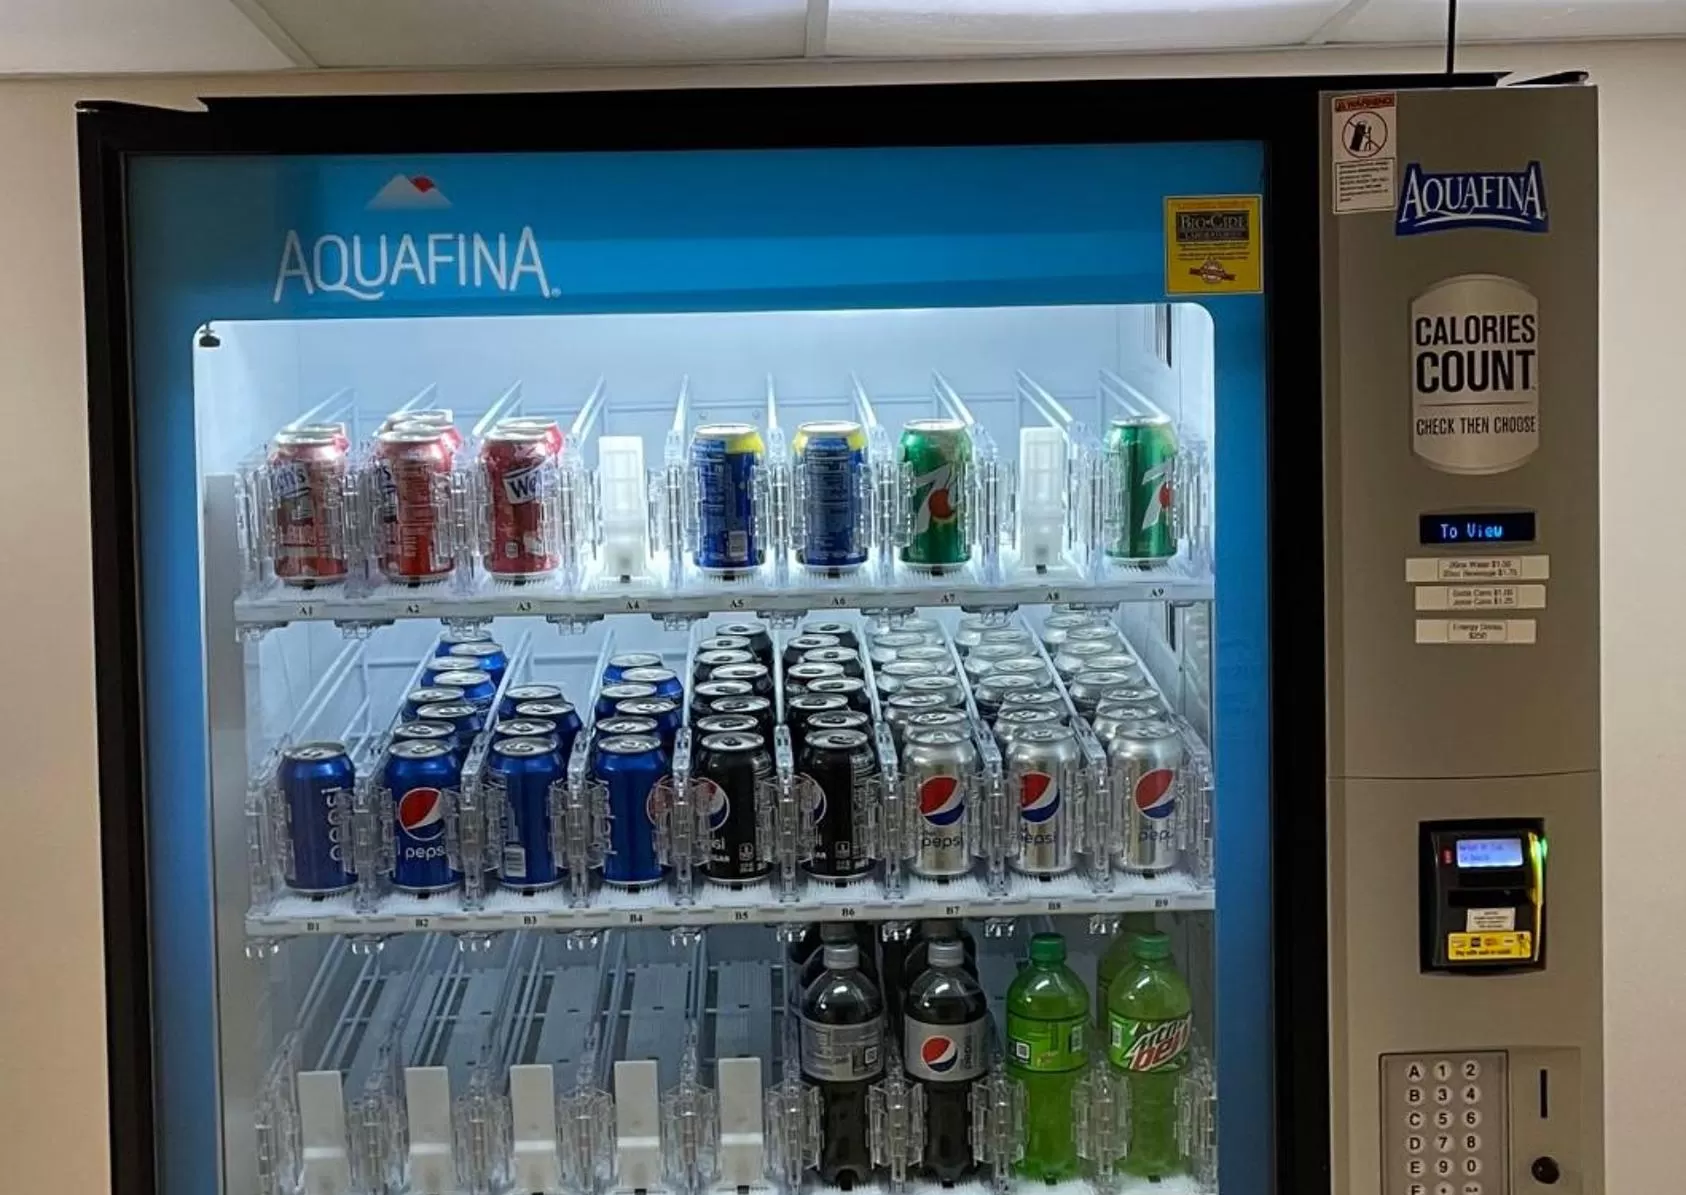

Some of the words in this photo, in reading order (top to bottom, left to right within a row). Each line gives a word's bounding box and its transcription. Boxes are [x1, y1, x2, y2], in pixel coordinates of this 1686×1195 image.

[1399, 167, 1546, 224] AQUAFINA
[273, 225, 553, 304] AQUAFINA
[1415, 314, 1536, 346] CALORIES
[1416, 349, 1536, 394] COUNT
[1416, 417, 1455, 436] CHECK
[1460, 416, 1489, 434] THEN
[1494, 415, 1536, 434] CHOOSE
[1440, 523, 1458, 539] To
[1466, 522, 1503, 538] View
[940, 593, 955, 603] A7
[1043, 592, 1059, 601] A8
[1148, 588, 1164, 597] A9
[516, 601, 531, 611] A3
[626, 600, 639, 610] A4
[730, 600, 744, 609] A5
[831, 597, 846, 606] A6
[299, 606, 313, 616] A1
[407, 604, 420, 614] A2
[404, 845, 447, 861] peps
[1409, 1065, 1420, 1078] A
[1439, 1065, 1446, 1077] 1
[1466, 1064, 1476, 1076] 2
[1409, 1089, 1420, 1102] B
[1438, 1088, 1447, 1101] 3
[1466, 1087, 1475, 1100] 4
[1409, 1113, 1421, 1126] C
[1439, 1113, 1447, 1125] 5
[1466, 1111, 1476, 1125] 6
[1409, 1137, 1421, 1150] D
[1439, 1137, 1447, 1149] 7
[1467, 1135, 1476, 1148] 8
[1410, 1161, 1421, 1174] E
[1439, 1160, 1448, 1173] 9
